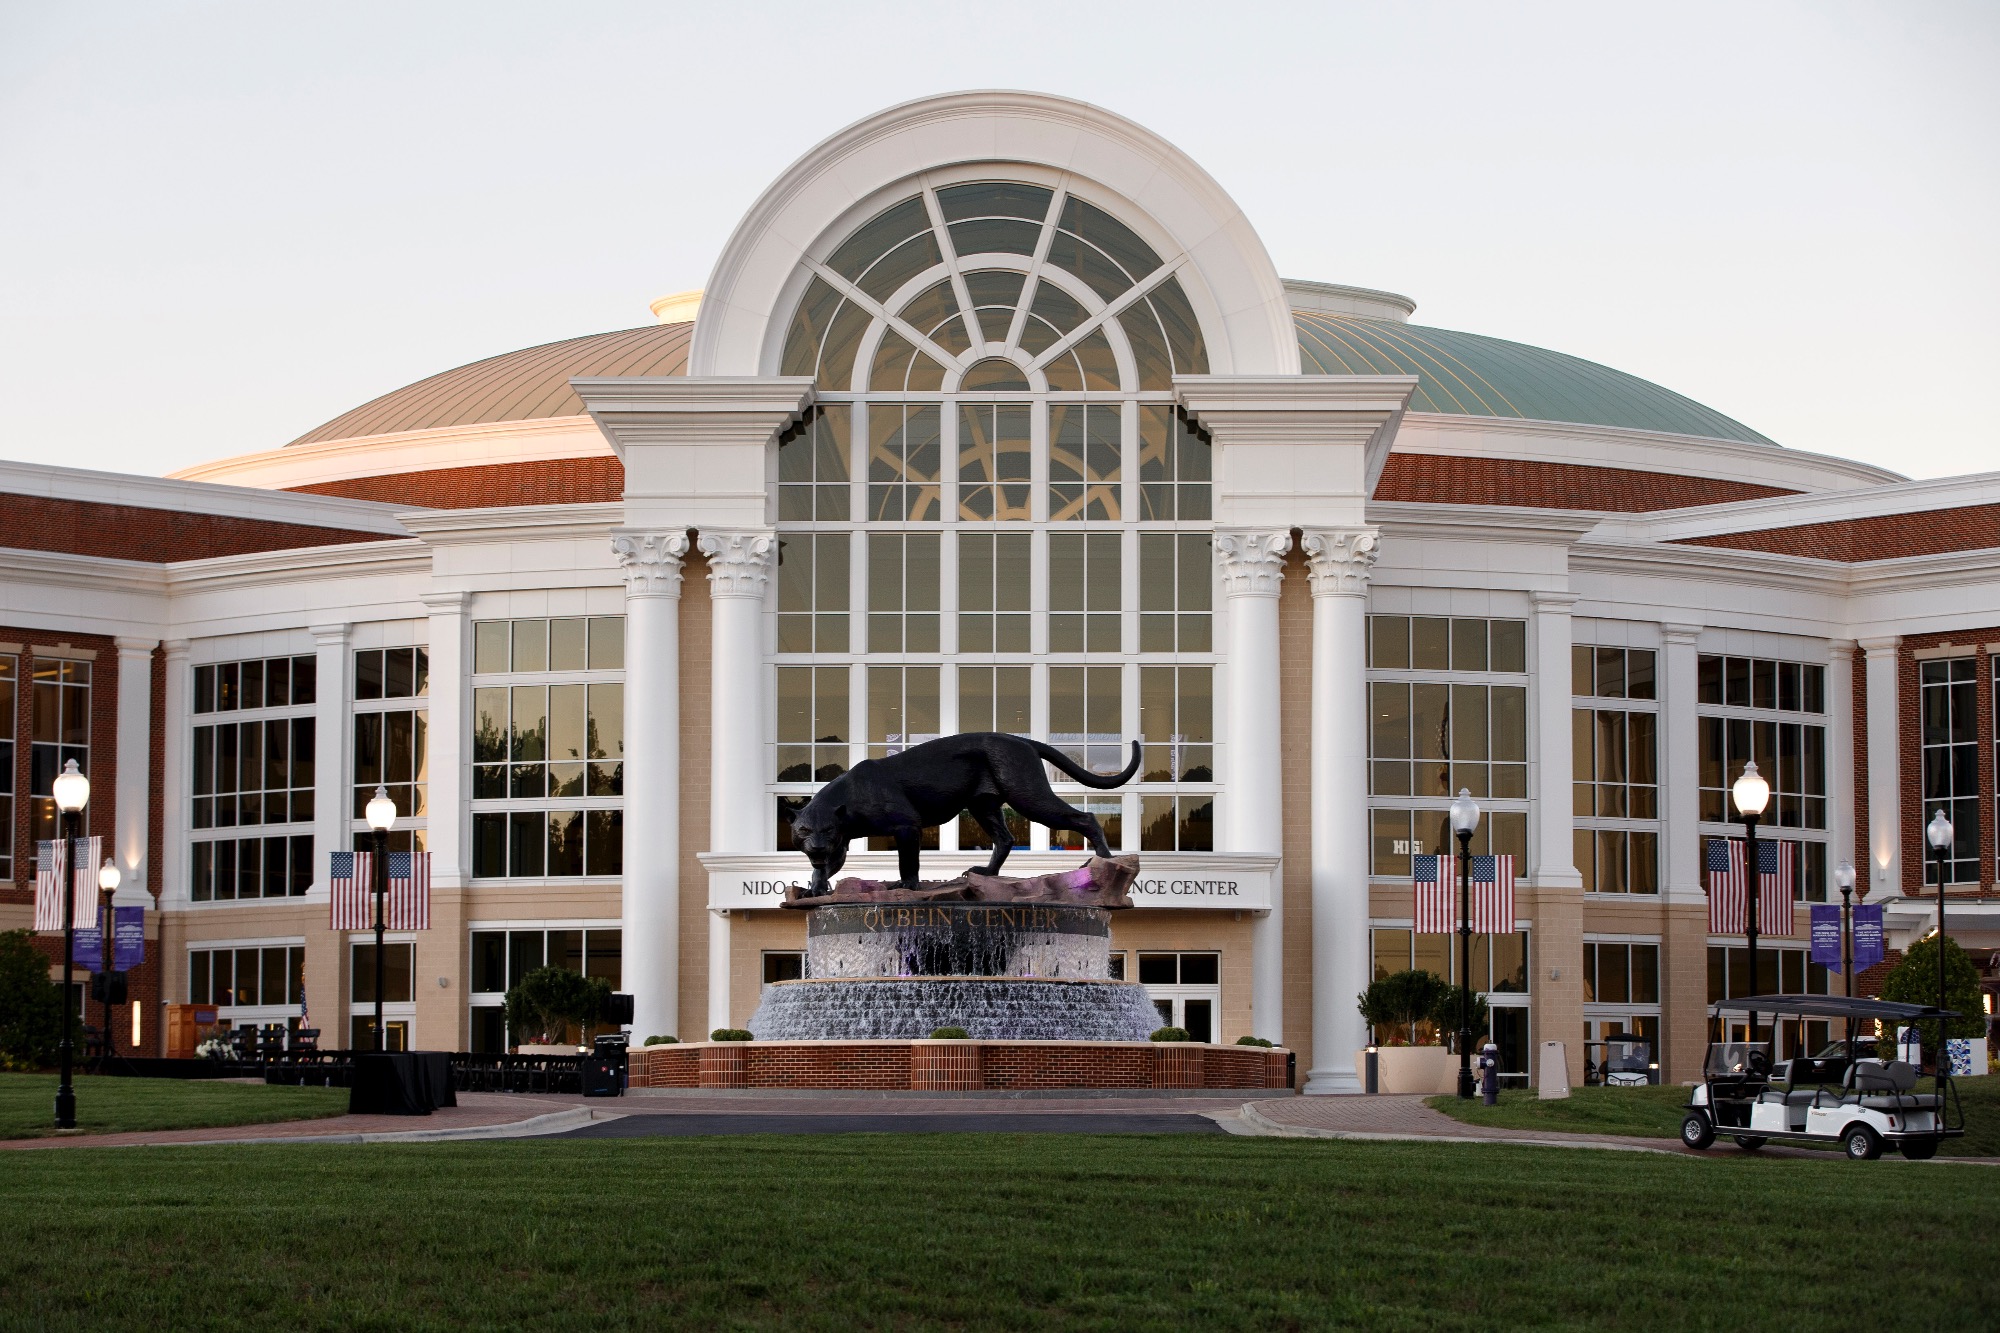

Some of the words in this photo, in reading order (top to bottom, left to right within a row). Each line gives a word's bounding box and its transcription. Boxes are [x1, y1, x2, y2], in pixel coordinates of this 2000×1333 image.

[1393, 840, 1423, 854] HIG
[742, 880, 786, 895] NIDO
[1127, 880, 1167, 895] NCE
[1171, 880, 1239, 896] CENTER
[863, 908, 952, 932] QUBEIN
[966, 908, 1058, 928] CENTER
